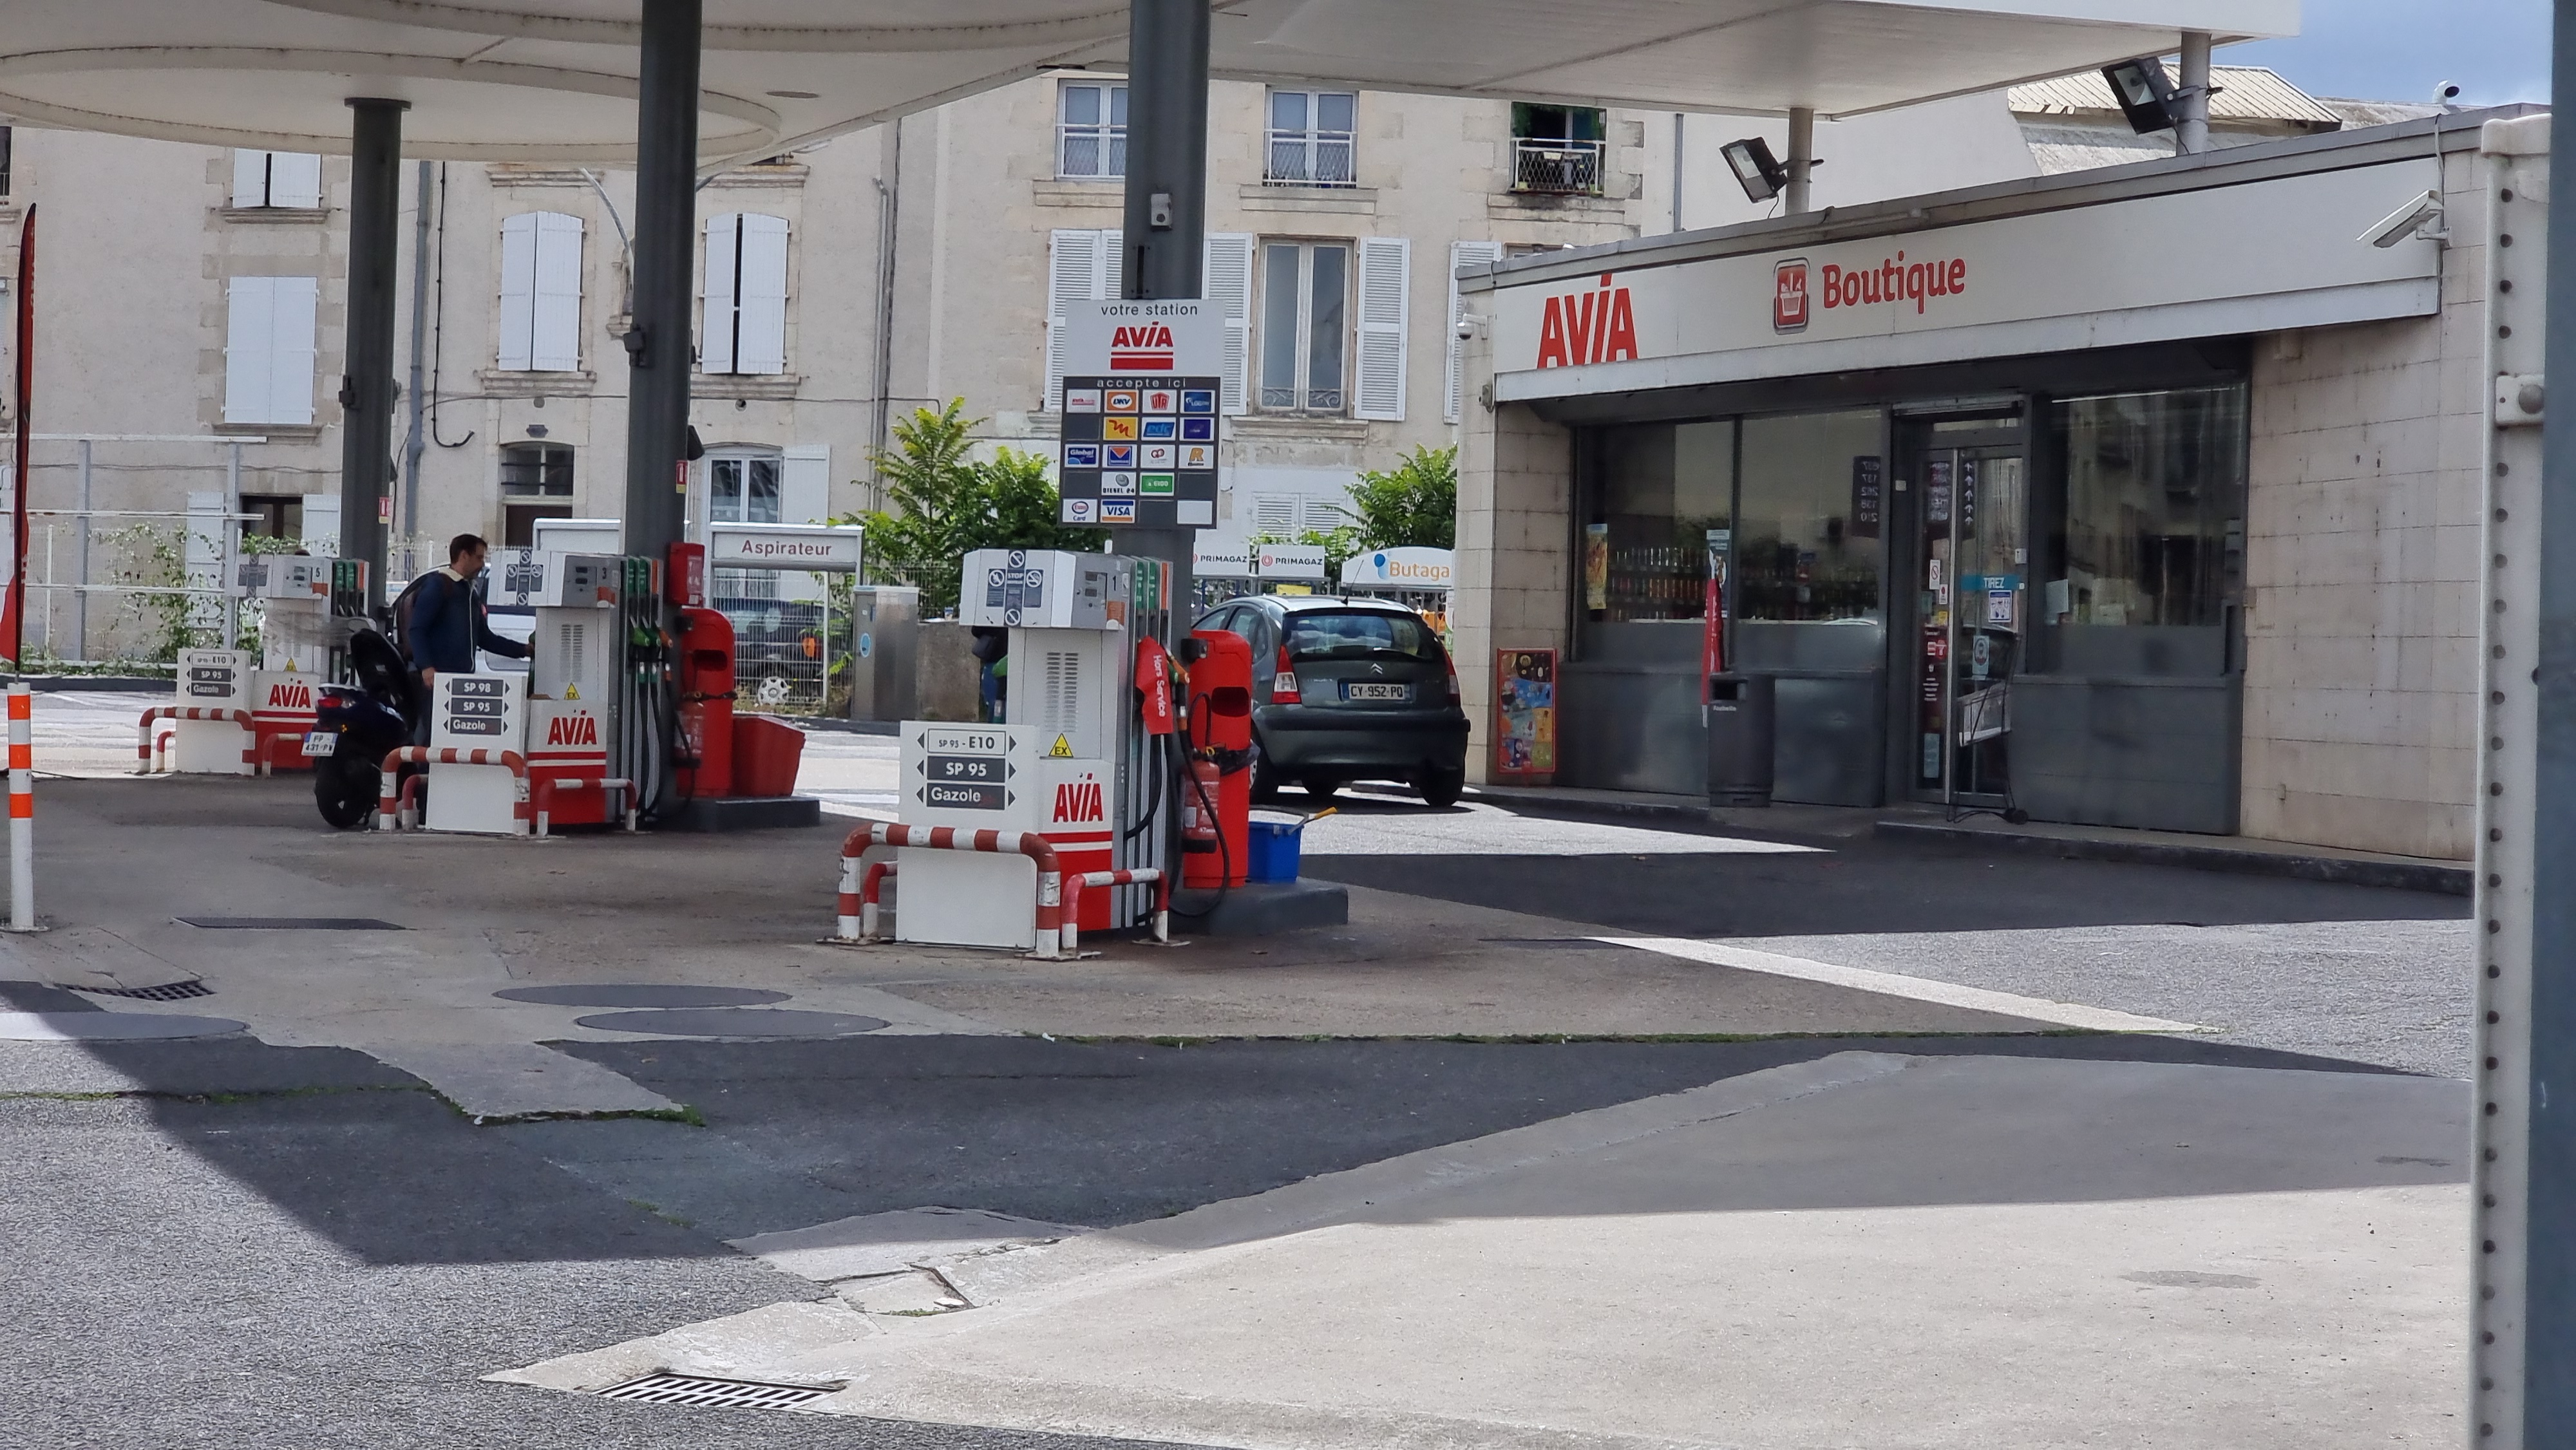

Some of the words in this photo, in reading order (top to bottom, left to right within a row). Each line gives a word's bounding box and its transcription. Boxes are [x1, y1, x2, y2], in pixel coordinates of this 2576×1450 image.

[1822, 250, 1965, 314] Boutique
[1101, 304, 1139, 315] votre
[1146, 303, 1198, 315] station
[1537, 273, 1638, 369] AVIA
[1112, 321, 1173, 347] AVIA
[1097, 378, 1160, 390] accepte
[1168, 377, 1186, 388] ici
[1106, 506, 1131, 516] VISA
[741, 540, 832, 558] Aspirateur
[1200, 555, 1248, 563] PRIMAGAZ
[1275, 558, 1323, 566] PRIMAGAZ
[602, 567, 607, 579] 3
[1389, 561, 1450, 581] Butaga
[1984, 577, 2005, 588] TIREZ
[1153, 654, 1163, 677] Hors
[193, 684, 219, 693] Gazole
[269, 680, 311, 708] AVIA
[464, 682, 476, 692] SP
[478, 683, 491, 693] 98
[1156, 679, 1166, 717] Service
[463, 701, 475, 711] SP
[478, 702, 490, 712] 95
[453, 719, 486, 731] Gazole
[547, 710, 597, 745] AVIA
[938, 739, 949, 748] SP
[950, 740, 960, 749] 95
[969, 736, 995, 750] E10
[1054, 746, 1068, 756] EX
[945, 762, 964, 776] SP
[968, 763, 987, 777] 95
[931, 787, 981, 803] Gazole
[1053, 773, 1104, 823] AVIA
